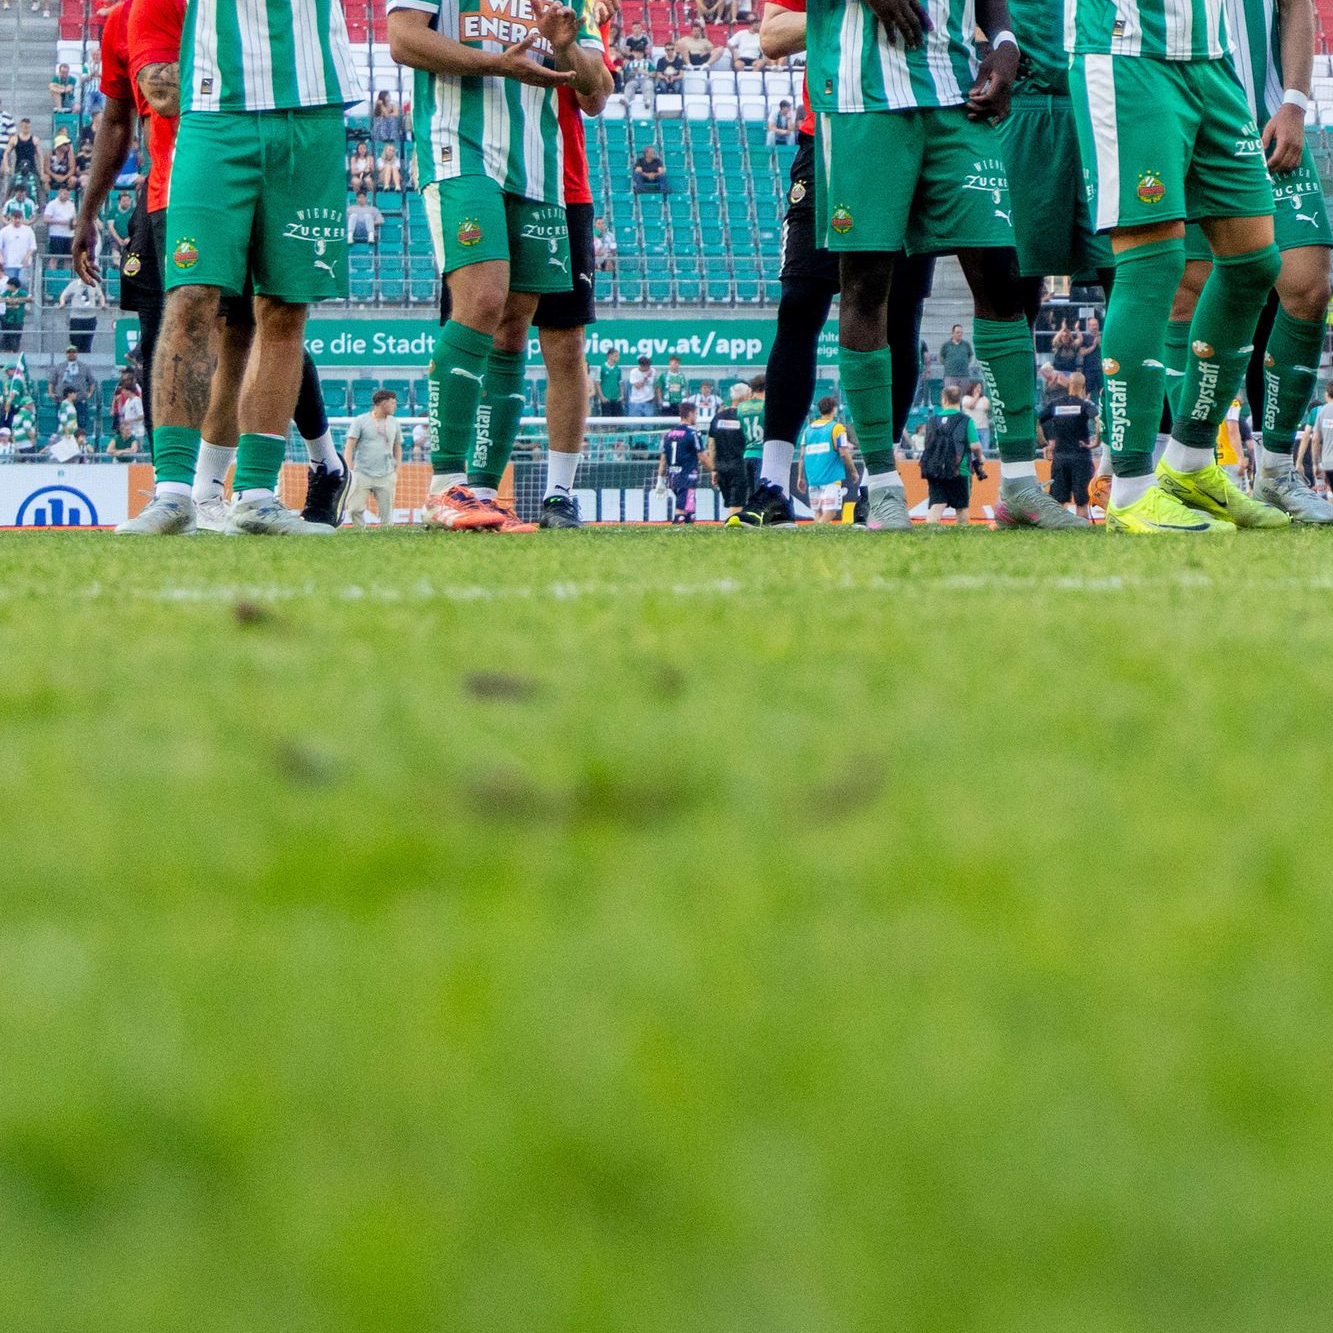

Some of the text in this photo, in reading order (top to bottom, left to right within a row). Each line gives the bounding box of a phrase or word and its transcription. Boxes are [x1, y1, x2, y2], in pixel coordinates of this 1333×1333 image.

[962, 174, 1009, 191] ZUCKE
[1274, 181, 1319, 198] UCKER
[330, 332, 367, 354] die
[373, 332, 436, 354] Stadt
[1264, 370, 1281, 431] easystaff
[1111, 378, 1130, 452] easystaff
[744, 416, 764, 442] 16
[670, 441, 677, 464] 1
